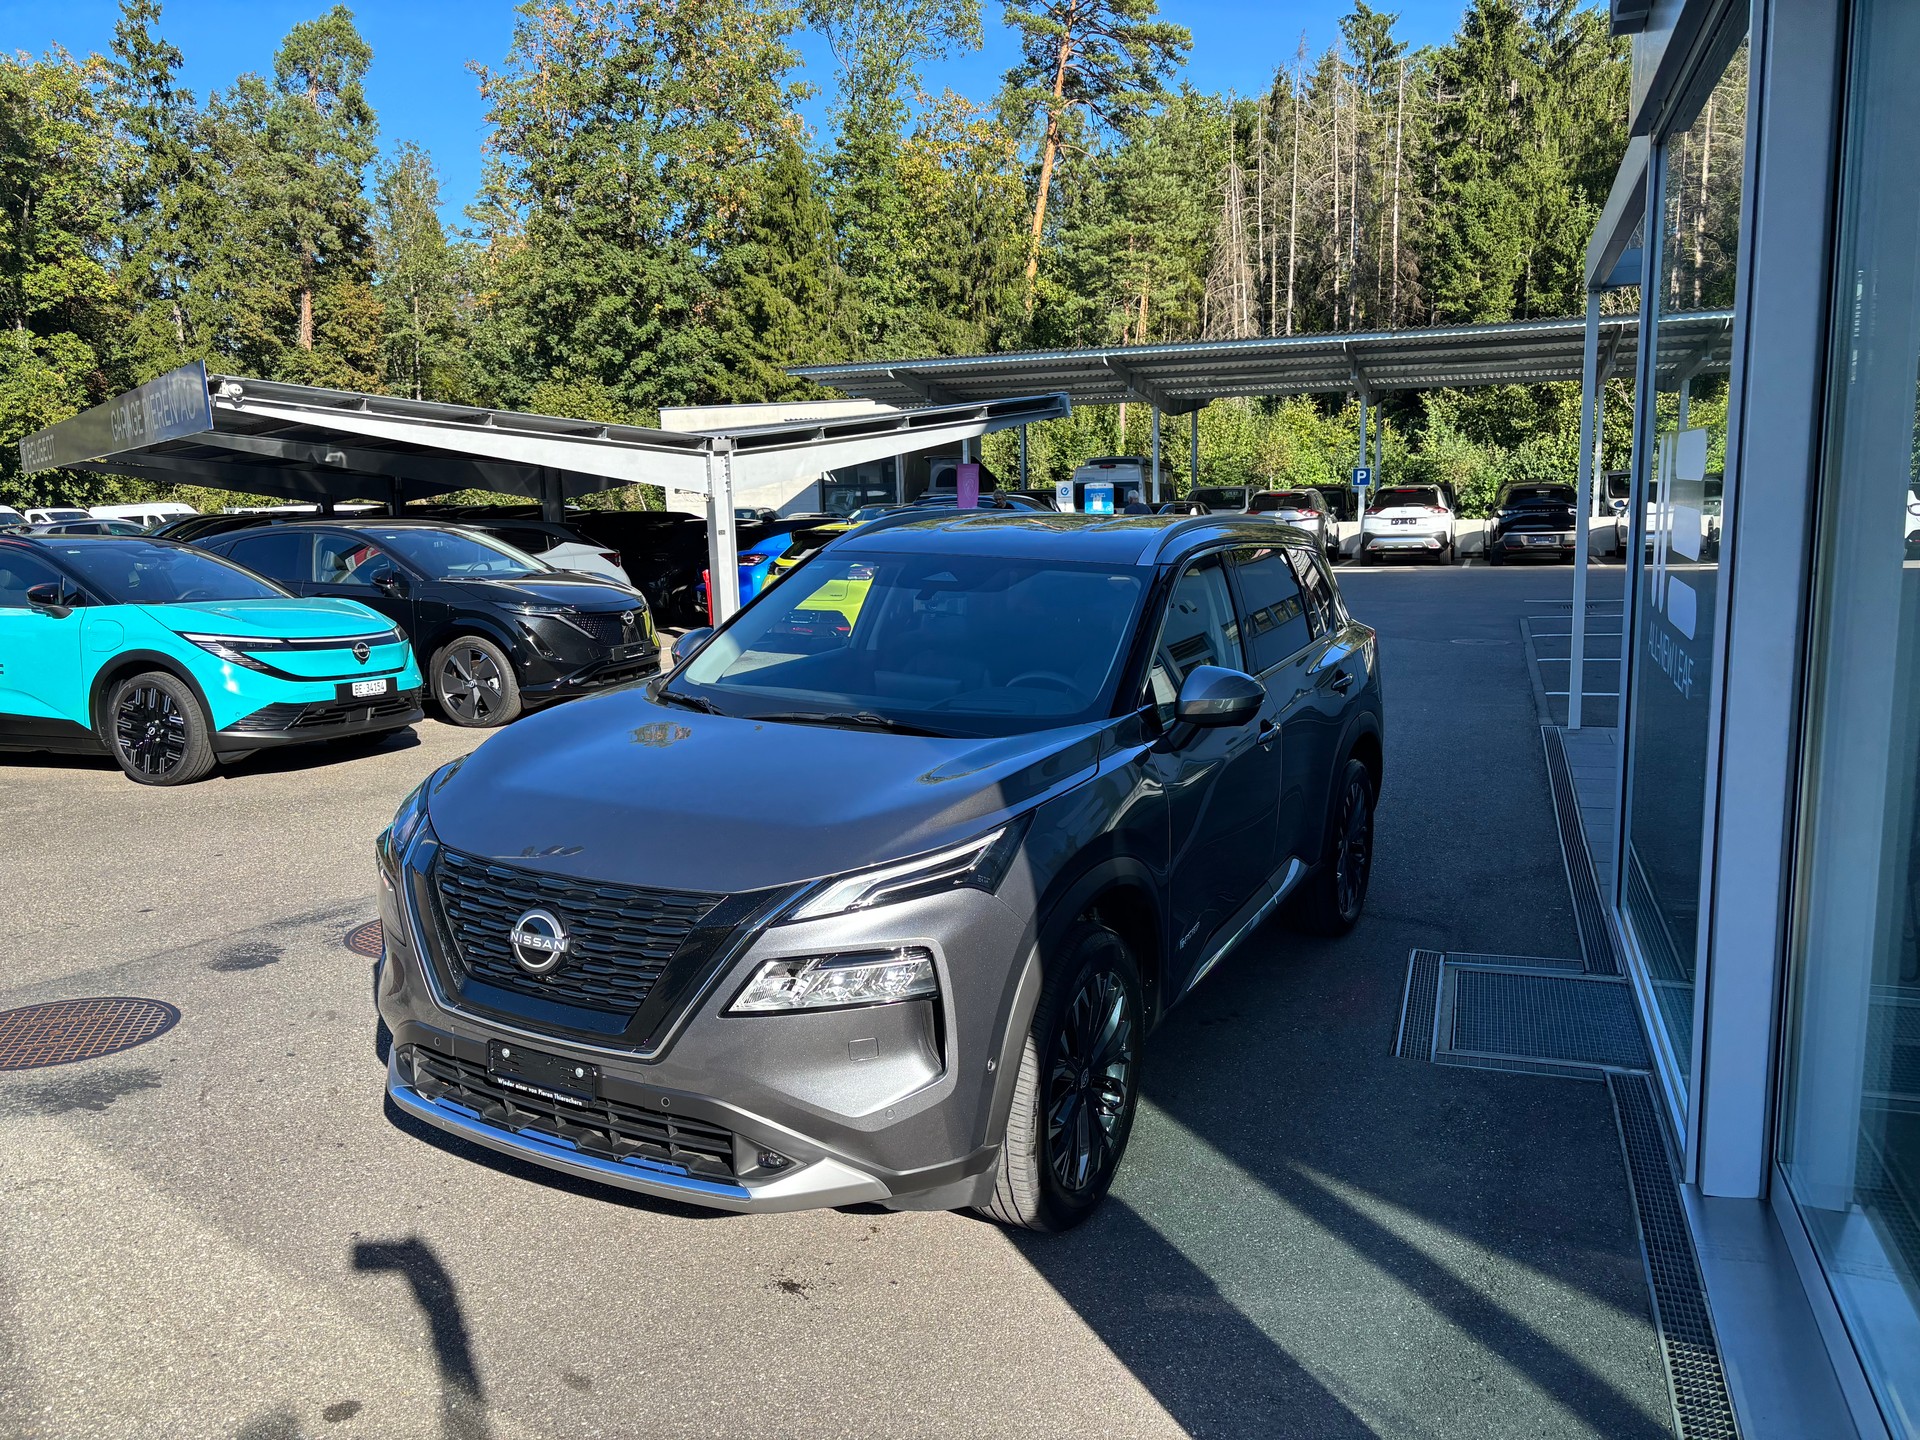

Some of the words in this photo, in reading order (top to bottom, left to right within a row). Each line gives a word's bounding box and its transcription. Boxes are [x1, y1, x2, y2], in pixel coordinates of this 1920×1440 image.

[111, 400, 143, 441] GARAGE
[142, 384, 179, 431] PIEREN
[1357, 470, 1366, 483] P
[1648, 620, 1674, 678] ALL-NEW
[1674, 645, 1694, 700] LEAF
[510, 931, 565, 951] NISSAN
[497, 1078, 514, 1088] Wieder
[528, 1087, 537, 1095] von
